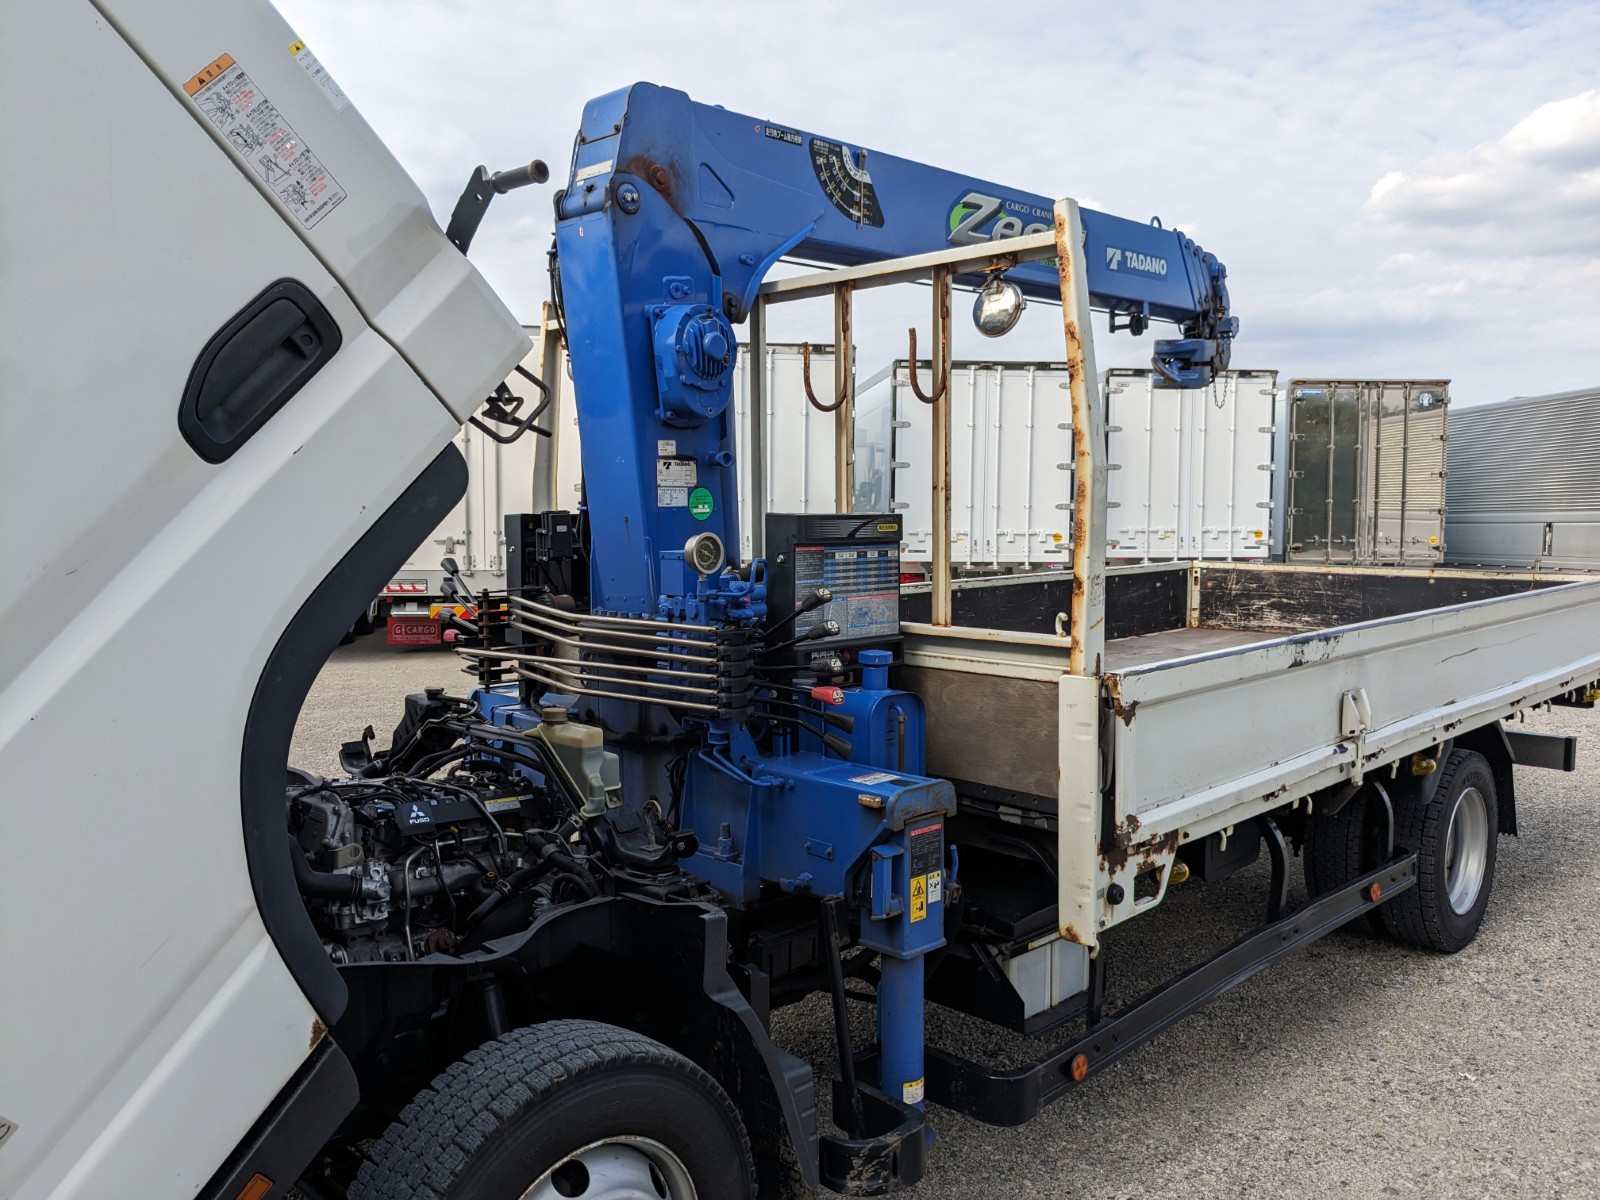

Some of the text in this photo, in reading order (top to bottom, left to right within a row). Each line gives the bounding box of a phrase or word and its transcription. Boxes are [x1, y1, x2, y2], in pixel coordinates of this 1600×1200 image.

[1006, 201, 1054, 220] CARGO CRANE
[1125, 251, 1167, 276] TADANO
[406, 626, 435, 634] CARGO
[409, 817, 430, 825] FUSO
